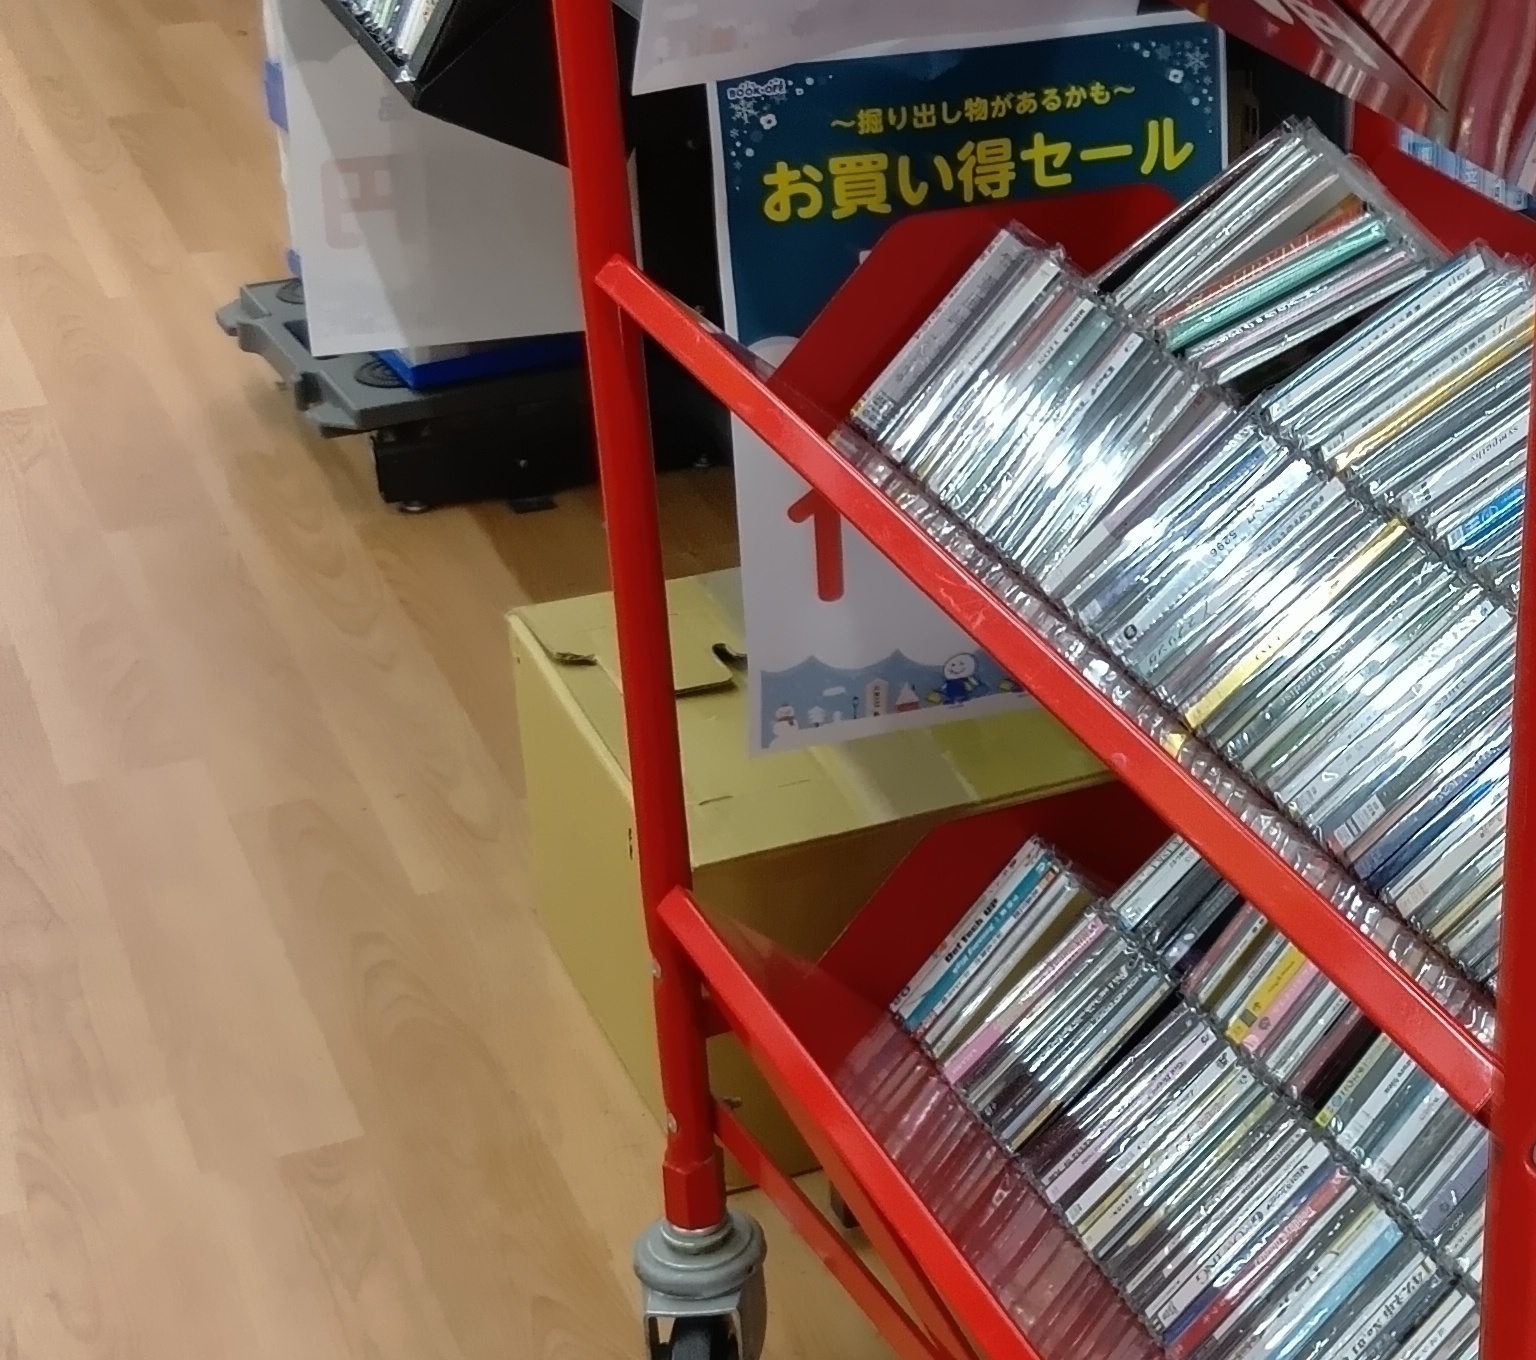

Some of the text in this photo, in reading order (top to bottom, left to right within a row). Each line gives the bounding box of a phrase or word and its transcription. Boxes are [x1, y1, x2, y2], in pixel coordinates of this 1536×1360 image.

[762, 117, 1194, 222] お買い得セール
[1465, 424, 1521, 465] sympathy
[1205, 528, 1239, 558] 5296
[942, 939, 966, 964] Def
[981, 896, 1001, 917] UP
